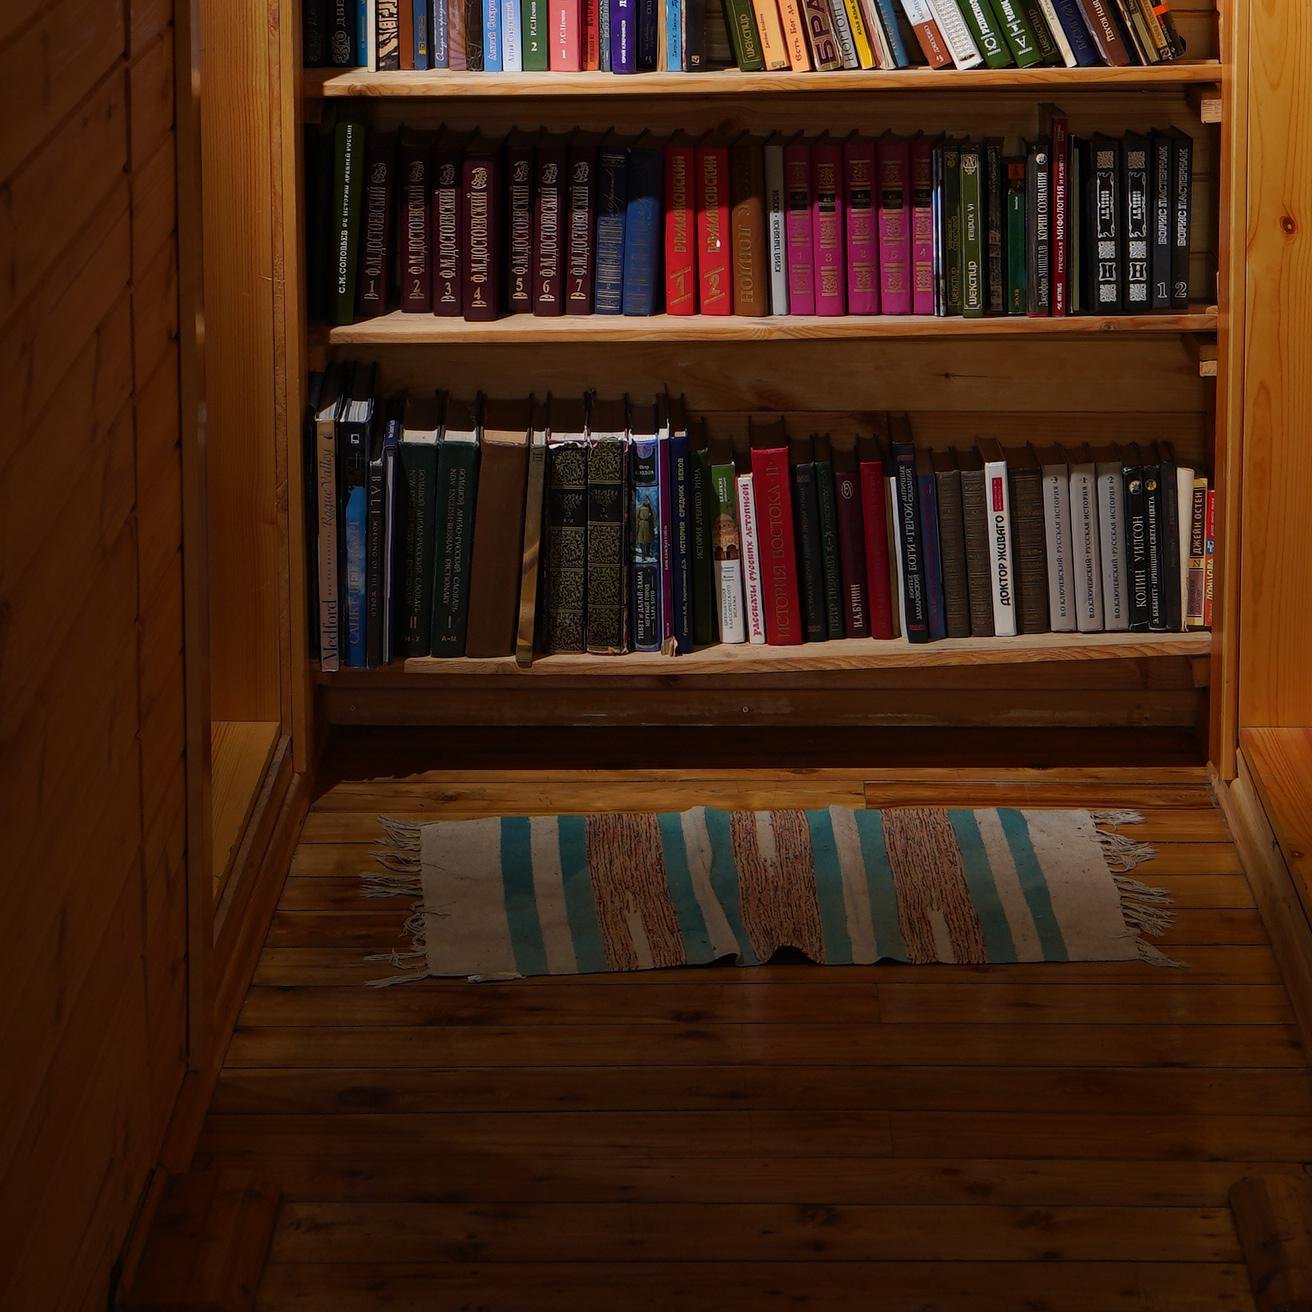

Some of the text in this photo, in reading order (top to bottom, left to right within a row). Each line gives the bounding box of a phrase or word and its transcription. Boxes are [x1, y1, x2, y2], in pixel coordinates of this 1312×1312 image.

[336, 0, 346, 27] ДВЕ
[832, 7, 854, 62] НОРТОН
[1001, 0, 1016, 21] МИРА
[1098, 16, 1116, 42] КОЛЕЦ
[531, 41, 538, 51] 2
[1037, 172, 1048, 213] СОЗНАНИЯ
[1055, 186, 1065, 240] МИФОЛОГИЯ
[1158, 146, 1168, 245] БОРИС ПАСТЕРНАК
[1177, 147, 1188, 247] БОРИС ПАСТЕРНАК
[364, 186, 386, 276] Ф.М.ДОСТОЕВСКИЙ
[403, 185, 429, 275] Ф.М.ДОСТОЕВСКИЙ
[435, 187, 462, 279] Ф.М.ДОСТОЕВСКИЙ
[466, 191, 492, 284] Ф.М.ДОСТОЕВСКИЙ
[509, 185, 532, 275] Ф.М.ДОСТОЕВСКИЙ
[538, 187, 560, 278] Ф.М.ДОСТОЕВСКИЙ
[569, 185, 590, 276] Ф.М.ДОСТОЕВСКИЙ
[1037, 214, 1048, 240] КОРНИ
[413, 279, 421, 291] 2
[1157, 282, 1167, 299] 1
[1174, 281, 1187, 298] 2
[677, 457, 687, 554] ИСТОРИЯ СРЕДНИХ ВЕКОВ
[768, 485, 786, 559] ВОСТОКА
[904, 501, 917, 536] ГЕРОИ
[1053, 485, 1062, 519] ИСТОРИЯ
[1082, 486, 1090, 520] ИСТОРИЯ
[1108, 485, 1117, 520] ИСТОРИЯ
[1192, 491, 1203, 555] ДЖЕЙН ОСТЕН
[906, 544, 918, 571] БОГИ
[994, 515, 1011, 606] ДОКТОР ЖИВАГО
[1054, 520, 1063, 554] РУССКАЯ
[1083, 522, 1092, 554] РУССКАЯ
[1110, 522, 1118, 555] РУССКАЯ
[1132, 515, 1148, 607] КОЛИН УИЛСОН
[774, 563, 792, 638] ИСТОРИЯ
[851, 584, 863, 628] И.А.БУНИН
[322, 599, 338, 663] Medford
